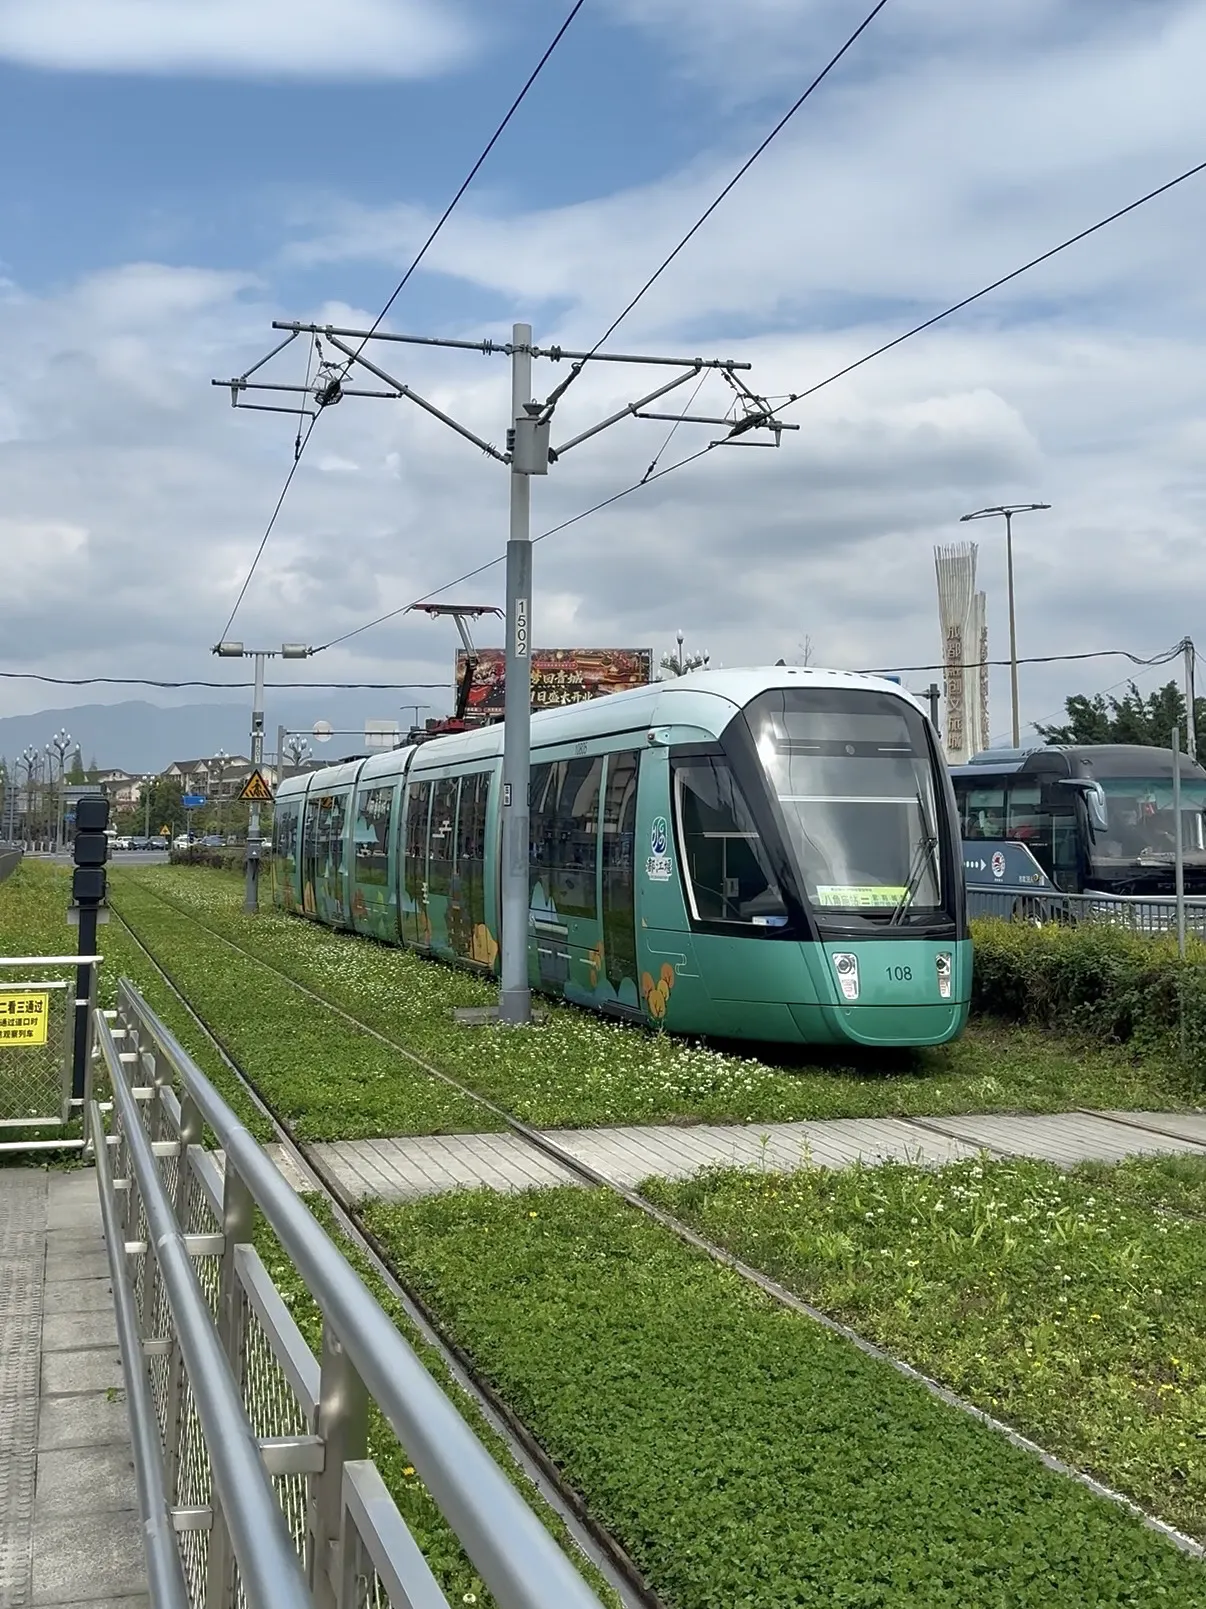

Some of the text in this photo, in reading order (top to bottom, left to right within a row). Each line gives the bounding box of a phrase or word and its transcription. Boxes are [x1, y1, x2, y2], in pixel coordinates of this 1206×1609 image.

[517, 601, 527, 656] 1502
[885, 966, 913, 981] 108
[0, 1000, 43, 1014] 二看三通过
[0, 1030, 34, 1039] 观察列车
